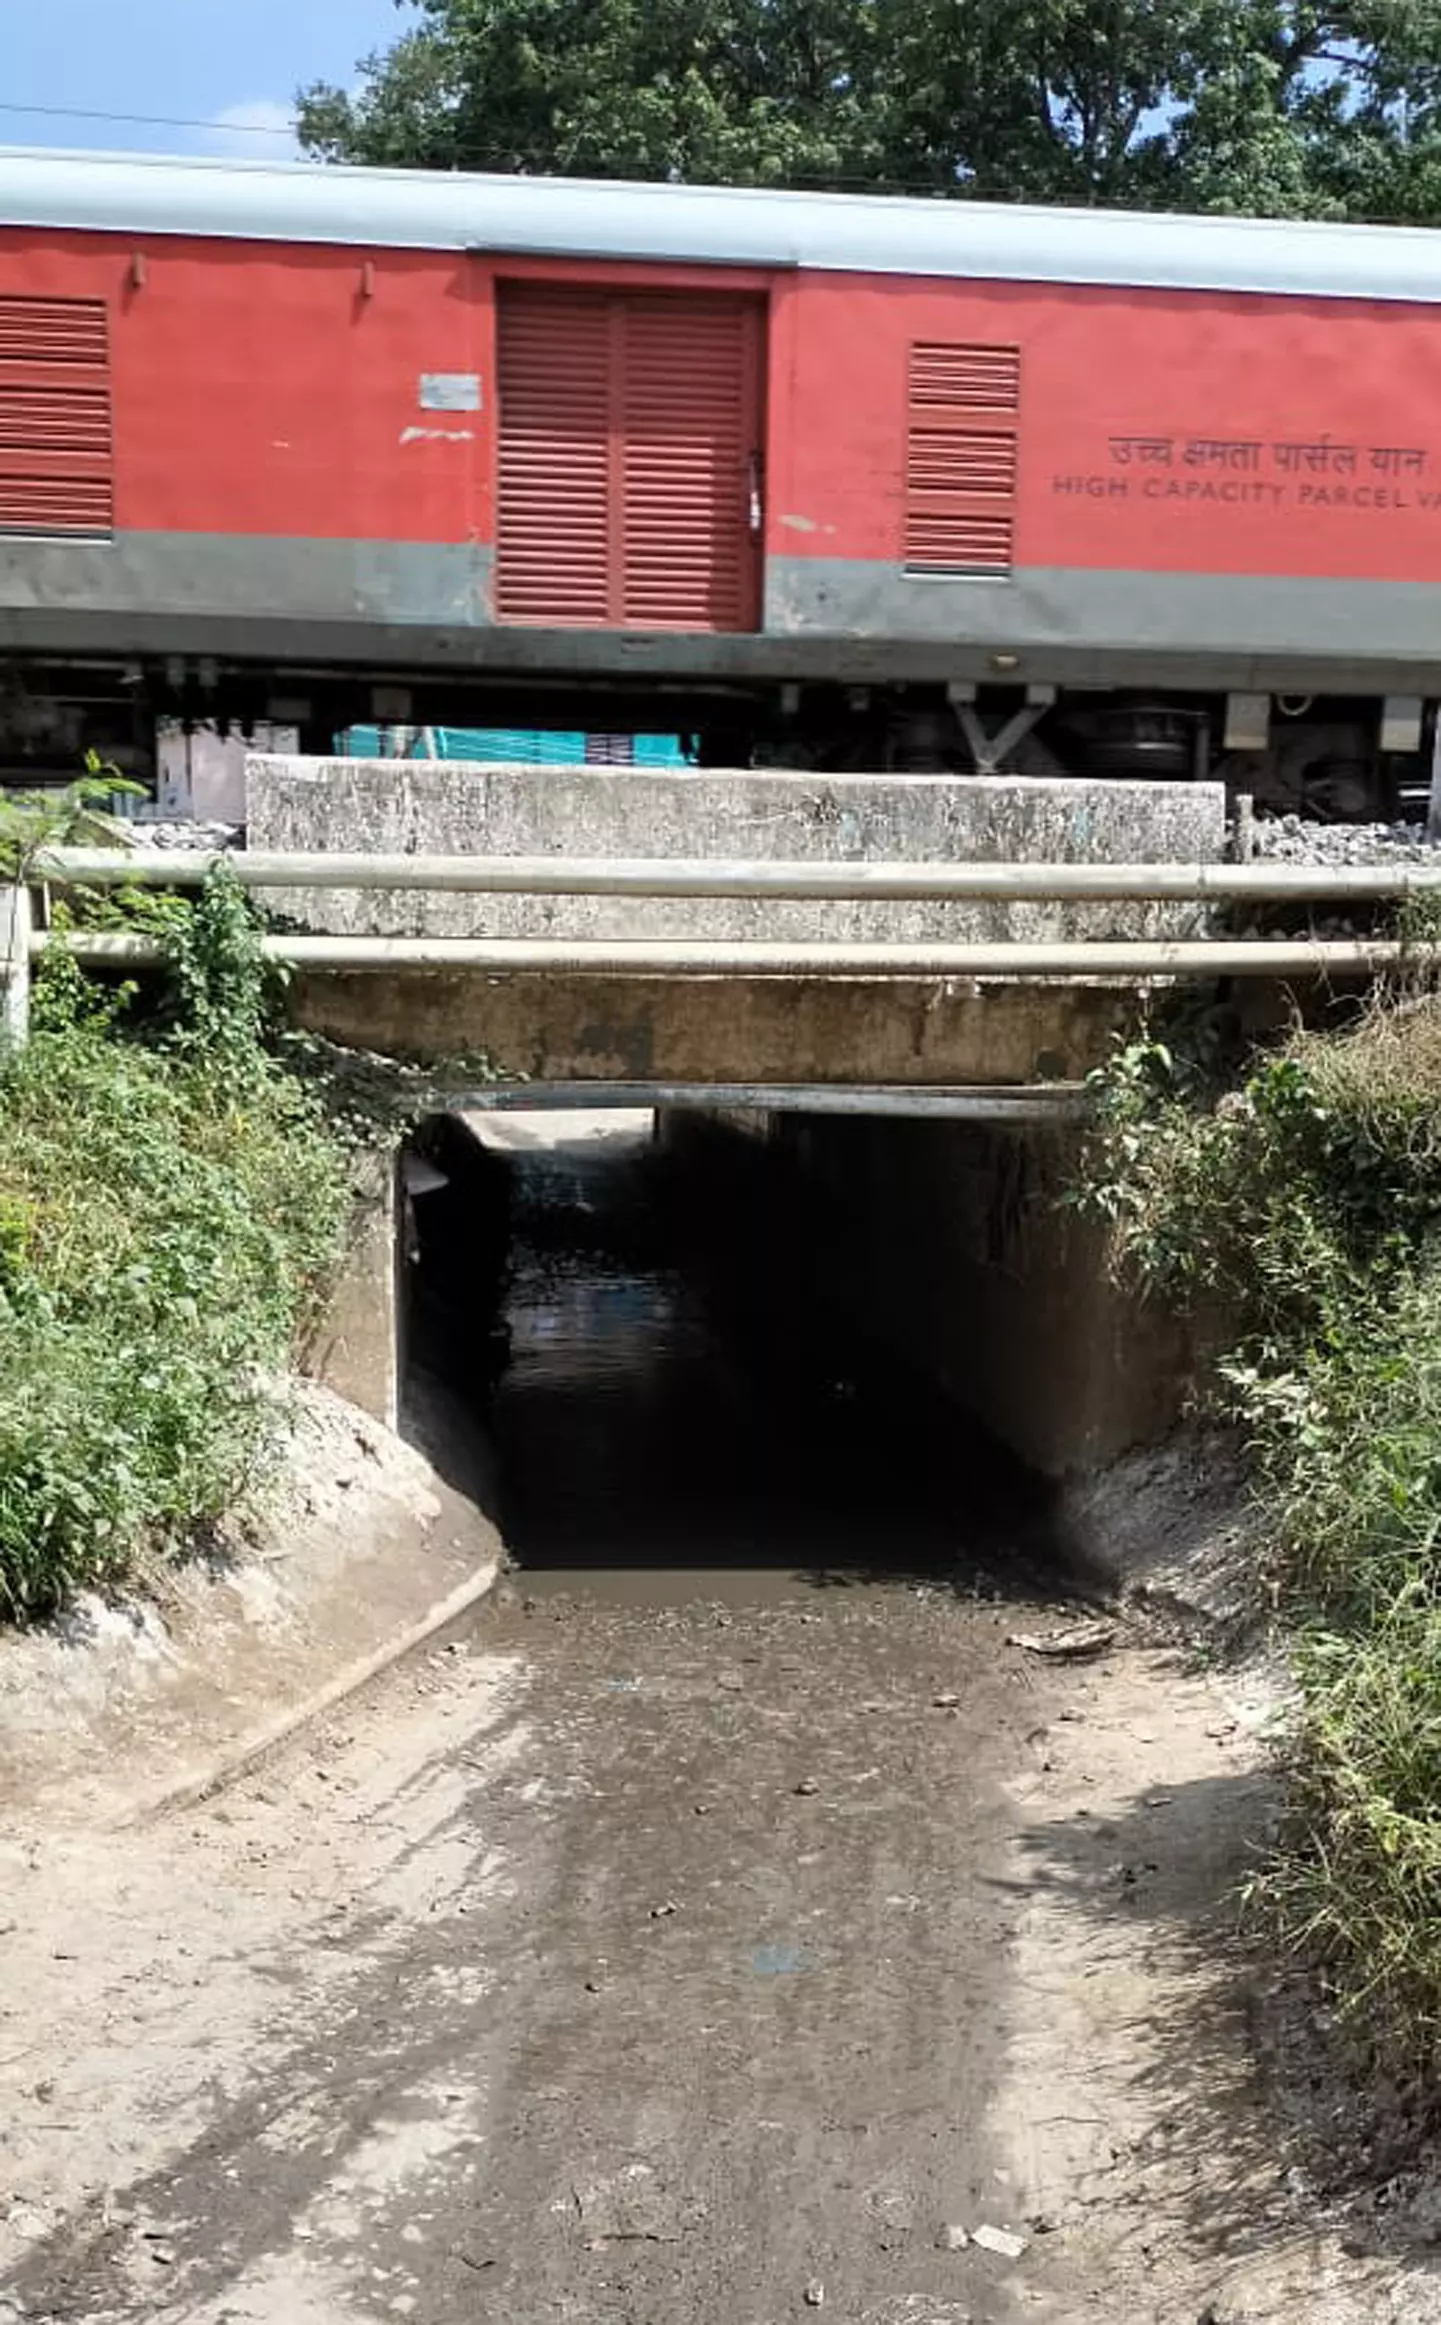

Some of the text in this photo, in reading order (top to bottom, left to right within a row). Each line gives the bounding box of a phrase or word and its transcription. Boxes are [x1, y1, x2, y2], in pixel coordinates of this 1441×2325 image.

[1108, 432, 1428, 477] उच्च क्षमता पार्सल यान
[1052, 475, 1128, 498] HIGH
[1143, 477, 1286, 505] CAPACITY
[1299, 482, 1408, 509] PARCEL
